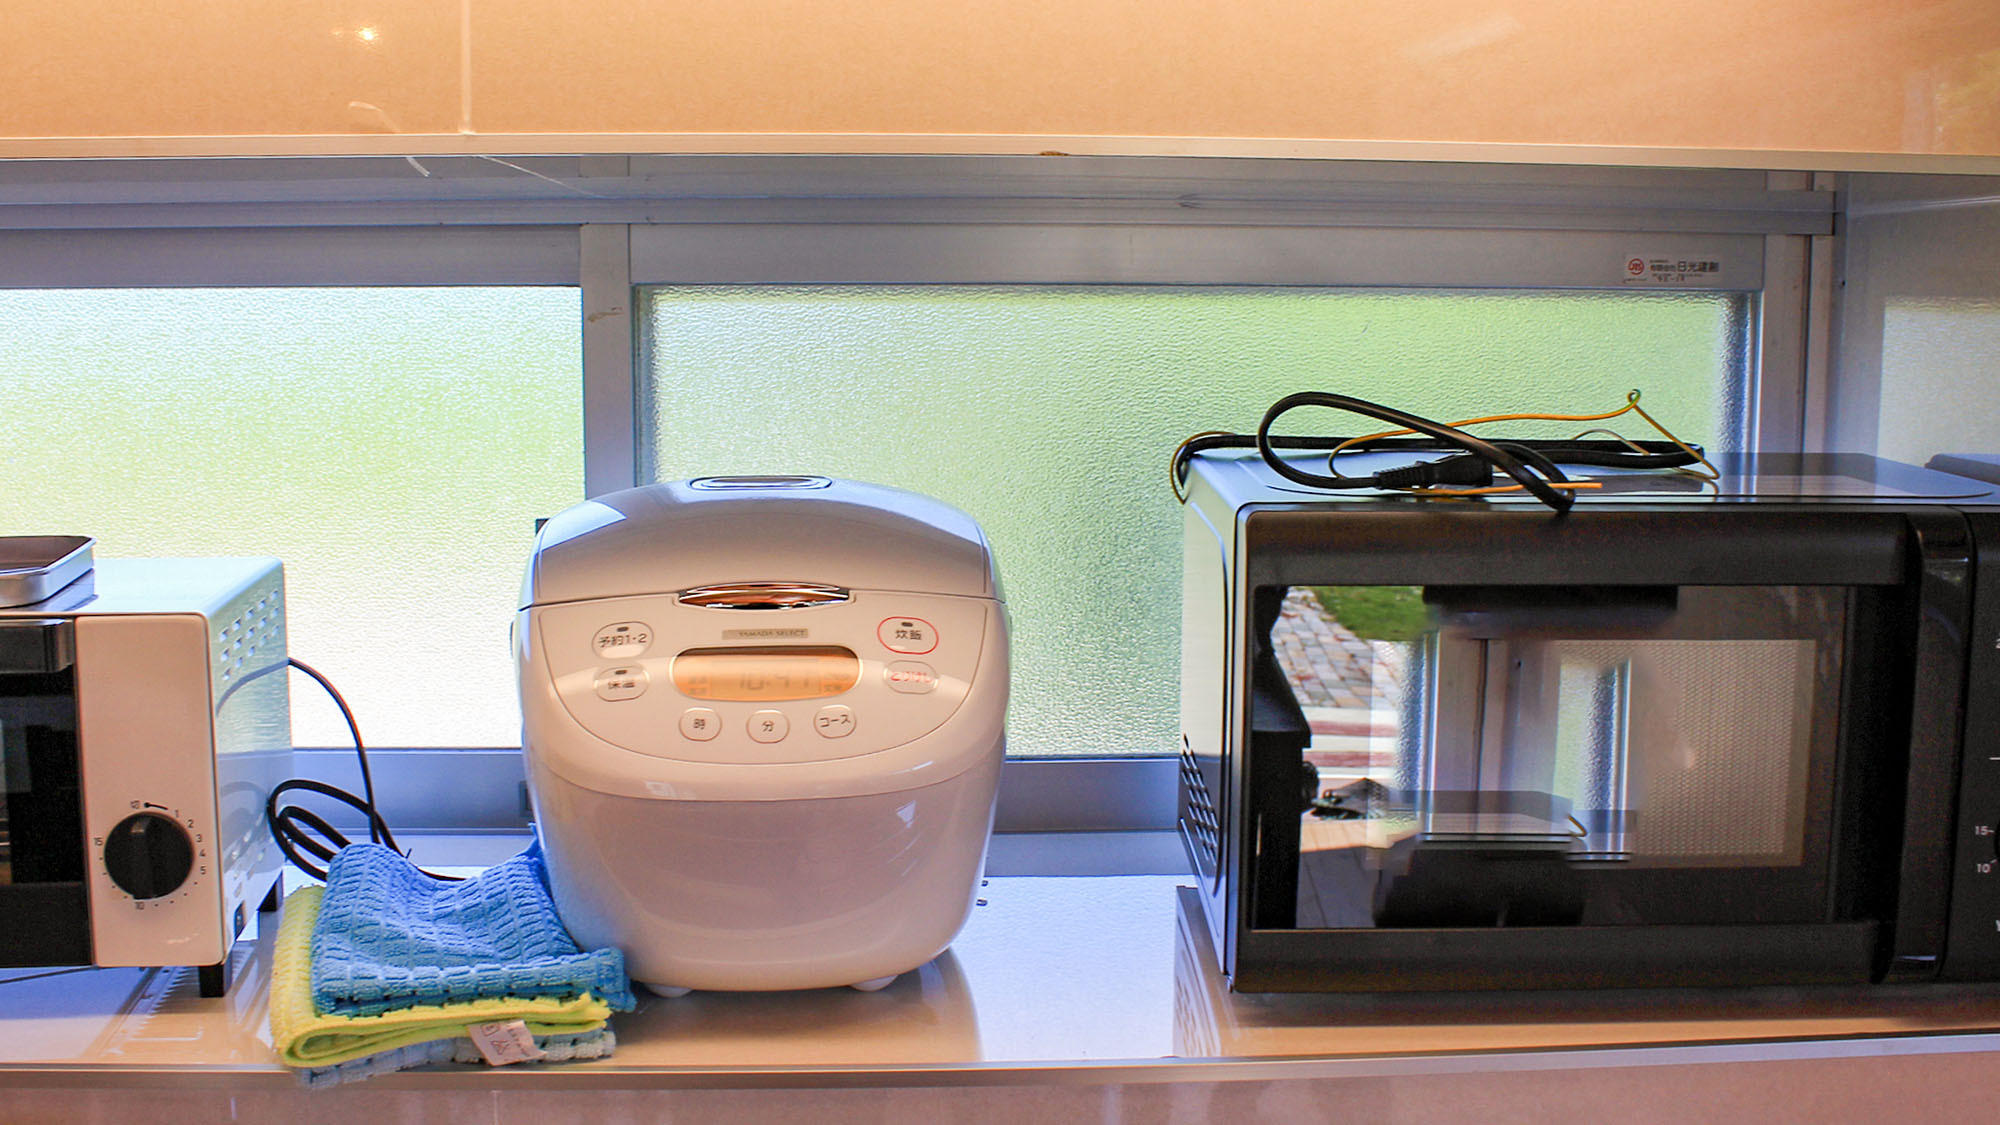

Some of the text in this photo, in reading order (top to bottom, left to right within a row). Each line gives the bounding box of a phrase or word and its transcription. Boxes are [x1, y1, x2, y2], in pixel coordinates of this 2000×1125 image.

[776, 629, 805, 637] SELECT
[895, 629, 922, 641] 炊飯
[693, 718, 706, 730] 時
[762, 720, 775, 732] 分
[819, 714, 851, 728] コース
[187, 819, 194, 829] 2
[1975, 825, 1988, 836] 15
[94, 837, 103, 847] 15
[196, 834, 203, 843] 3
[199, 850, 206, 858] 4
[200, 865, 206, 875] 5
[1977, 863, 1991, 873] 10
[135, 901, 145, 911] 10
